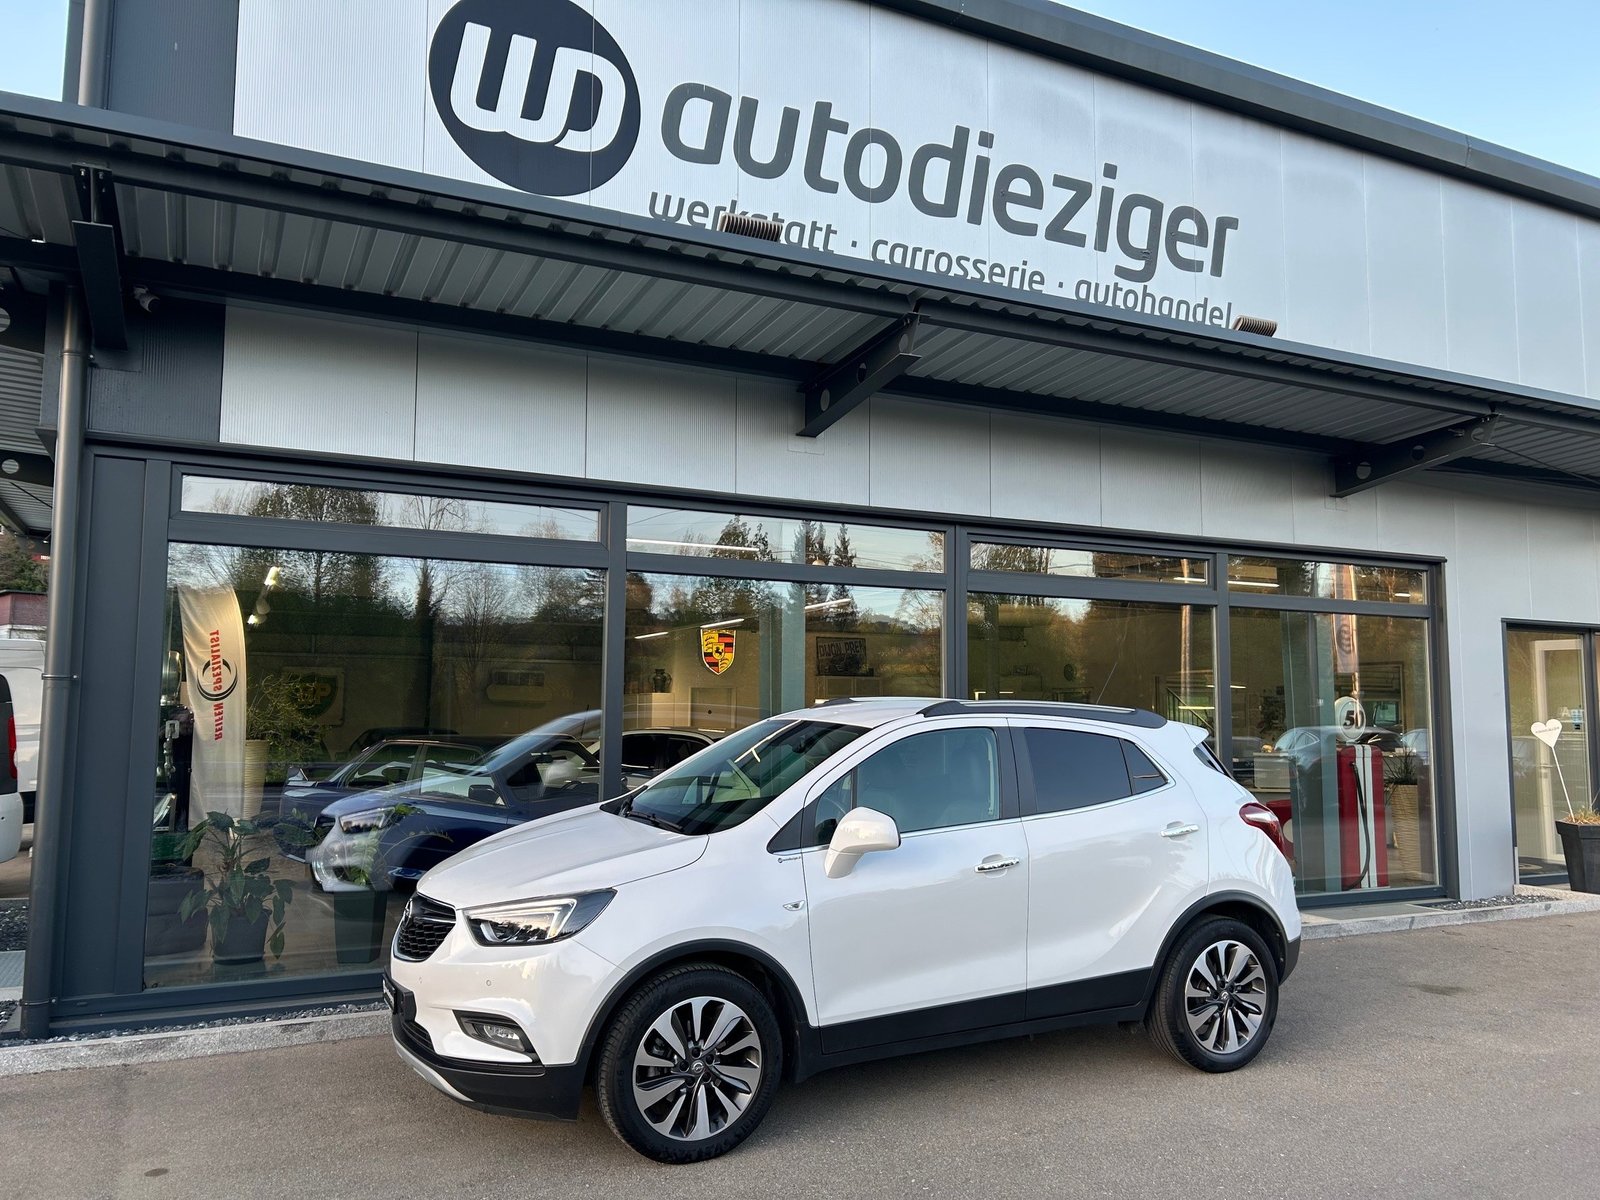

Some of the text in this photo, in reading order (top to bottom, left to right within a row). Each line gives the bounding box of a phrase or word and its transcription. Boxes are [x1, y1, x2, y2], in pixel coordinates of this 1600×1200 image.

[648, 191, 1233, 330] weratt carrosserie autohandel
[661, 82, 1240, 283] autodieziger
